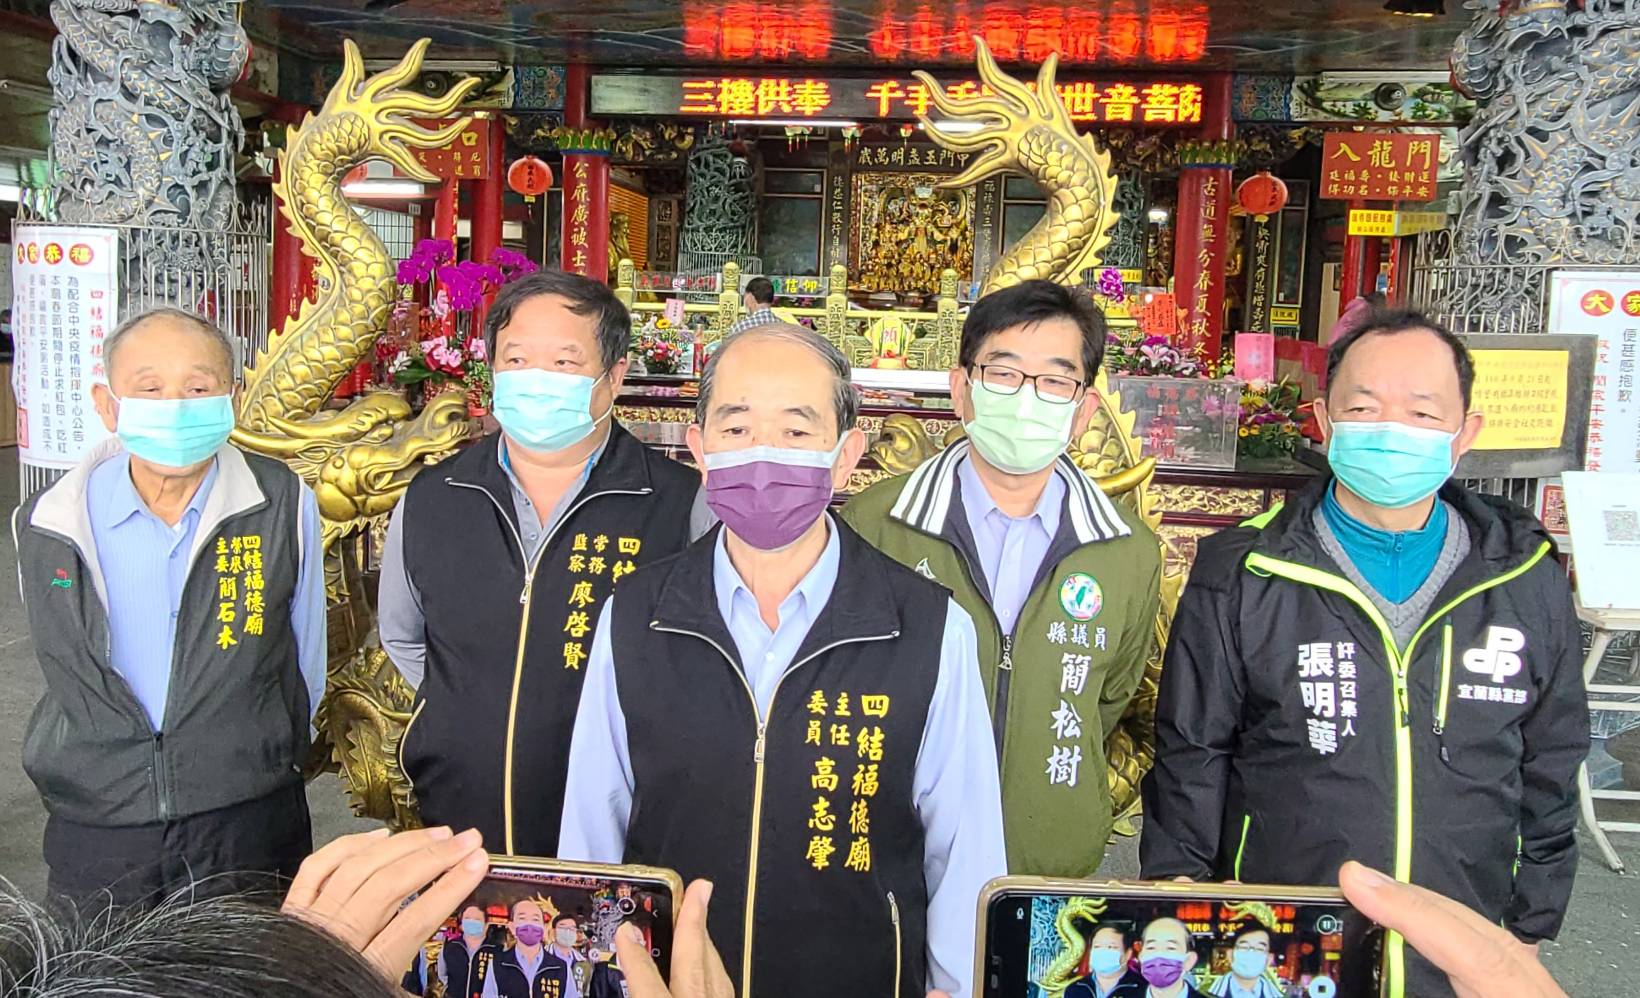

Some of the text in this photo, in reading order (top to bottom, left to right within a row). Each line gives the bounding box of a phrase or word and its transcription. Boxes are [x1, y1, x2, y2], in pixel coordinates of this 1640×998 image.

[1330, 139, 1432, 169] 入龍門
[571, 161, 591, 276] 公府廣被士
[242, 535, 265, 635] 四結福德廟
[1047, 621, 1108, 651] 縣議員
[1045, 652, 1092, 787] 簡松樹
[1297, 642, 1338, 755] 張明華
[1337, 641, 1358, 737] 評委召集人
[844, 694, 890, 872] 四結福德廟
